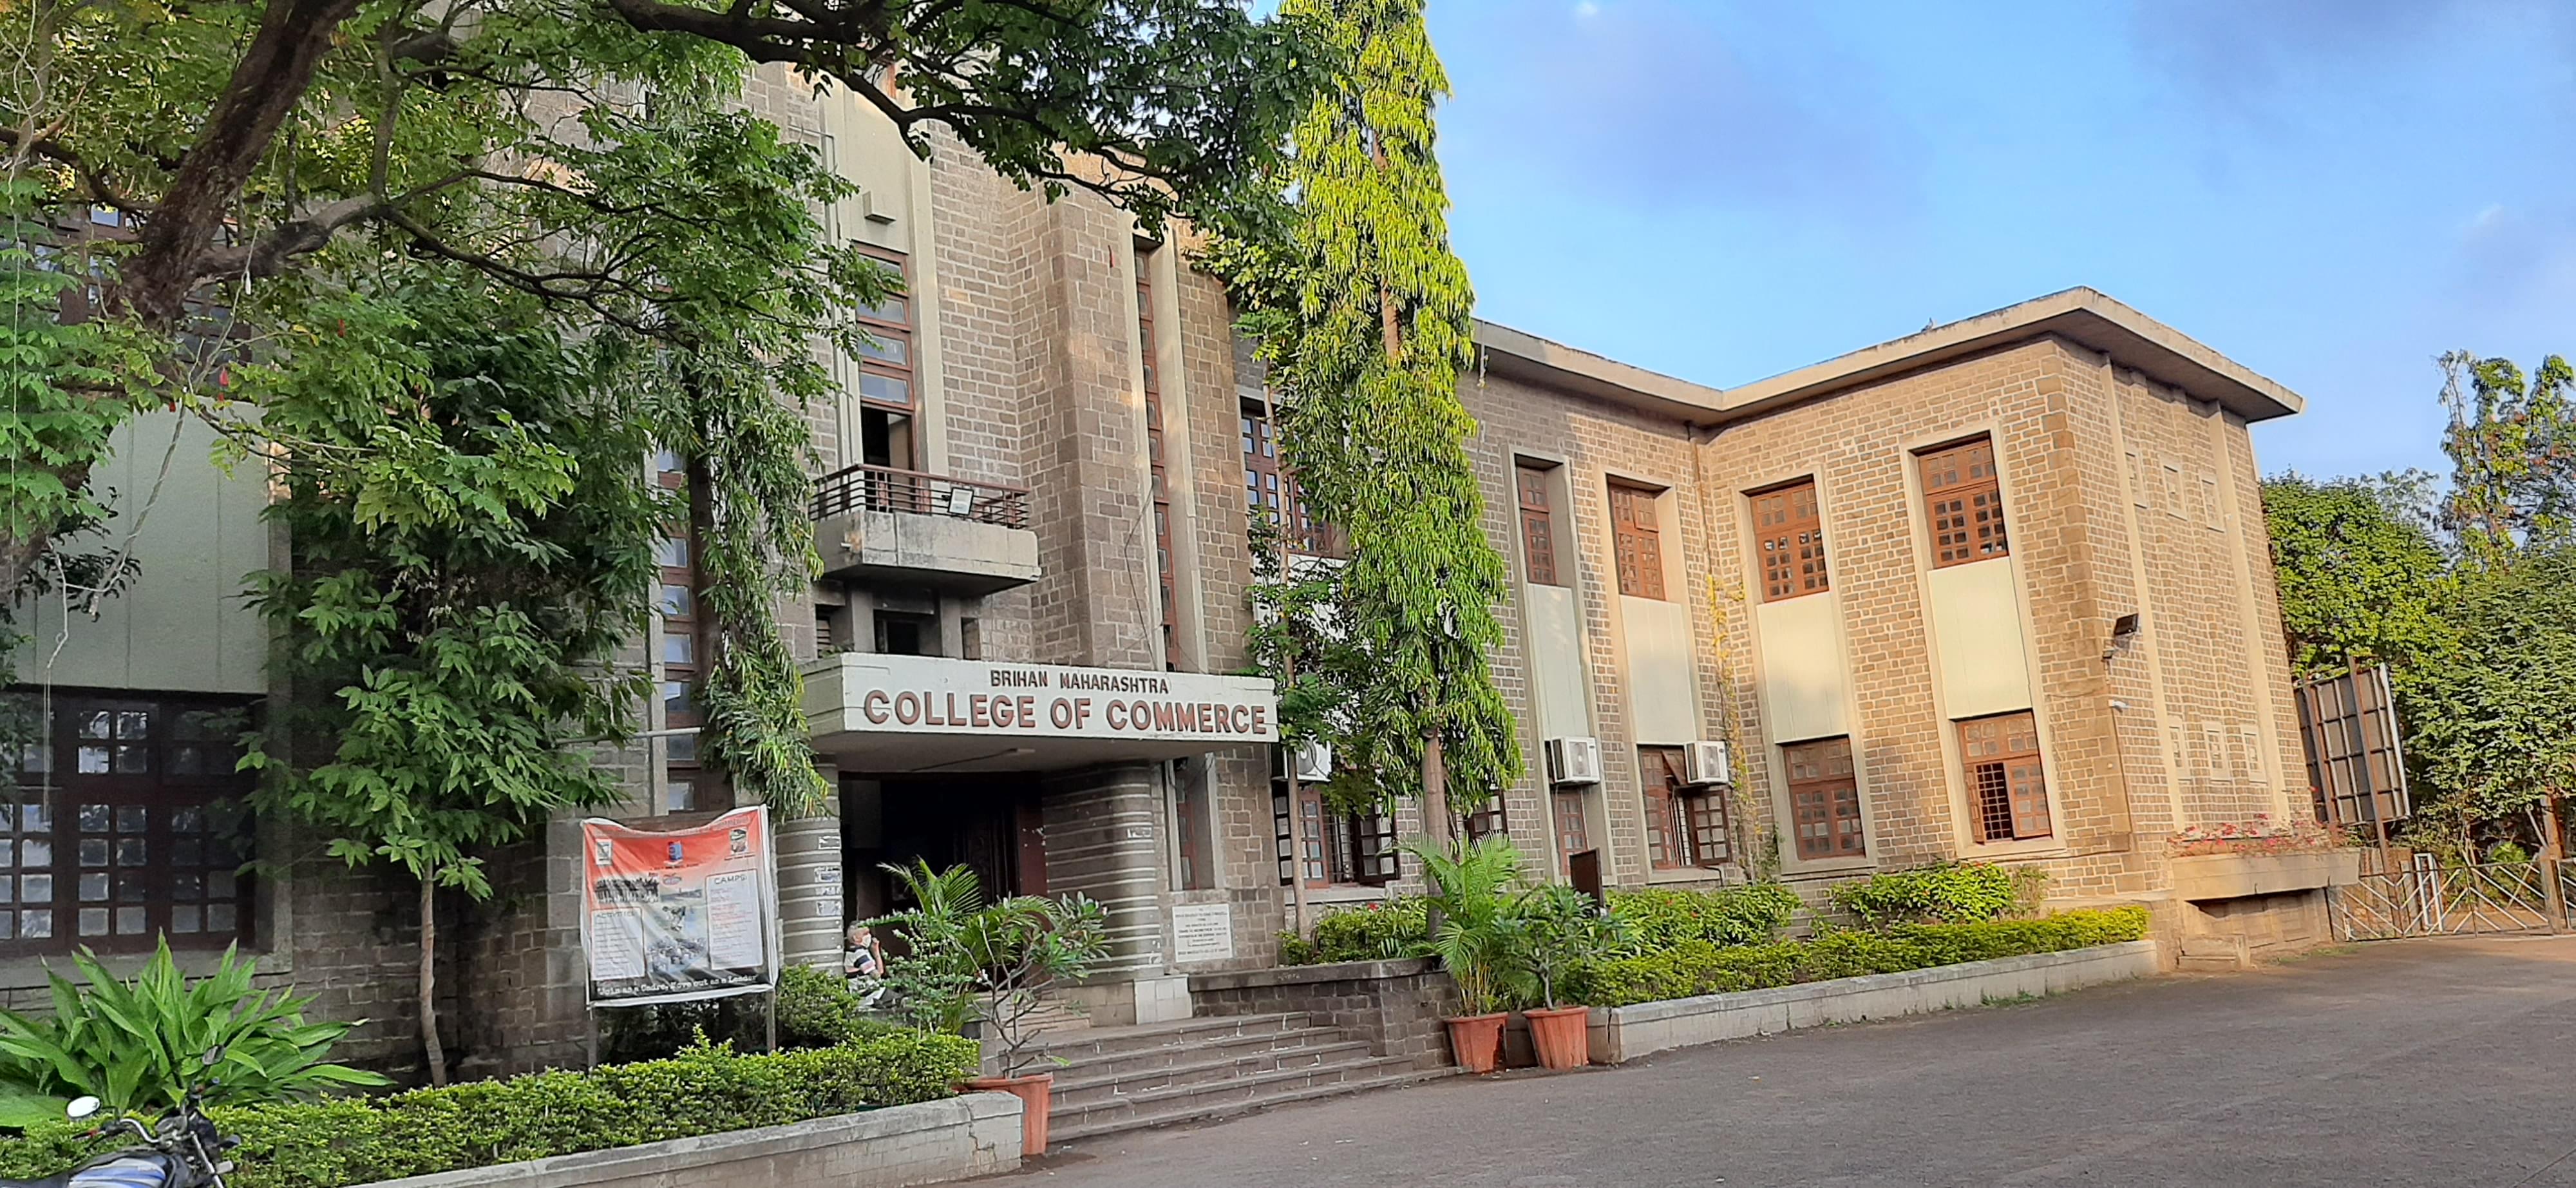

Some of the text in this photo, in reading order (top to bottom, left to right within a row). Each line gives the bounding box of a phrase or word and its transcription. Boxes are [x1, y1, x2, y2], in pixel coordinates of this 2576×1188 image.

[990, 669, 1169, 694] BRIHAN MAHARASHTRA
[864, 690, 1267, 734] COLLEGE OF COMMERCE
